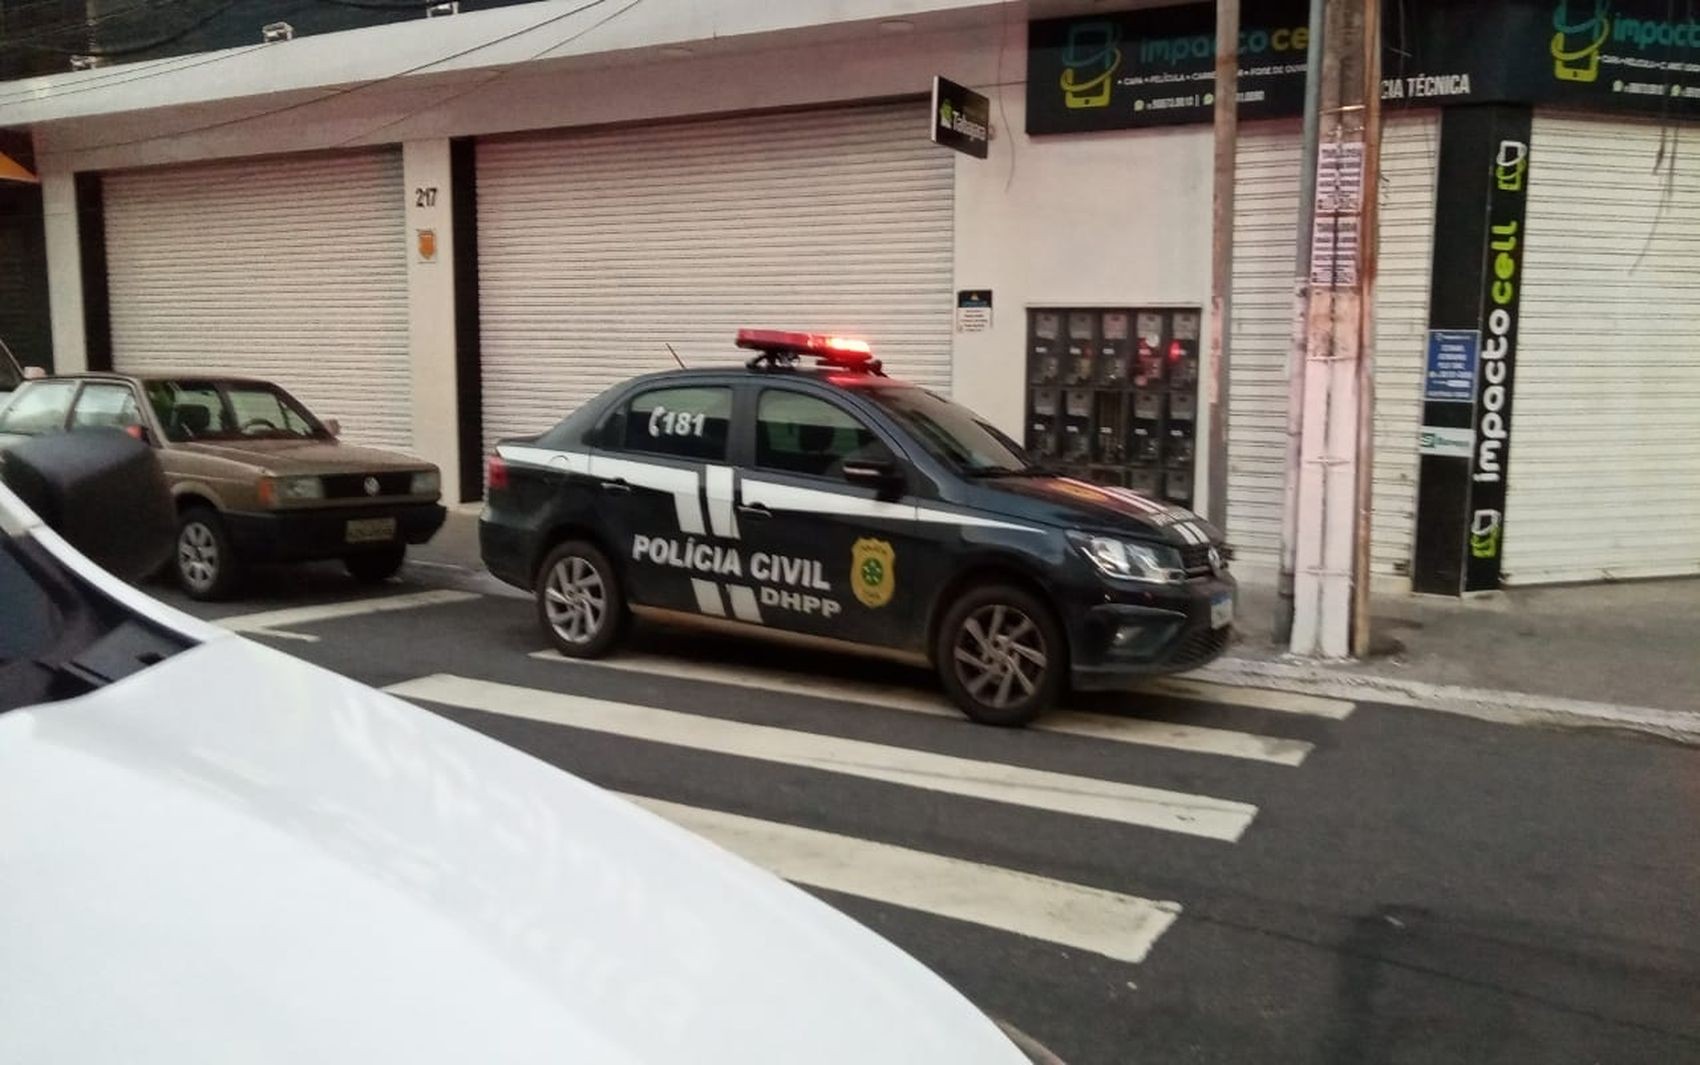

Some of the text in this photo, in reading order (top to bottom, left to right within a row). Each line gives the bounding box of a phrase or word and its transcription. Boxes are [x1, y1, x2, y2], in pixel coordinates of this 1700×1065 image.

[1406, 73, 1470, 97] TÉCNICA
[415, 187, 438, 208] 217
[663, 411, 706, 437] 181
[632, 534, 832, 590] POLÍCIA CIVIL
[760, 586, 842, 618] DHPP
